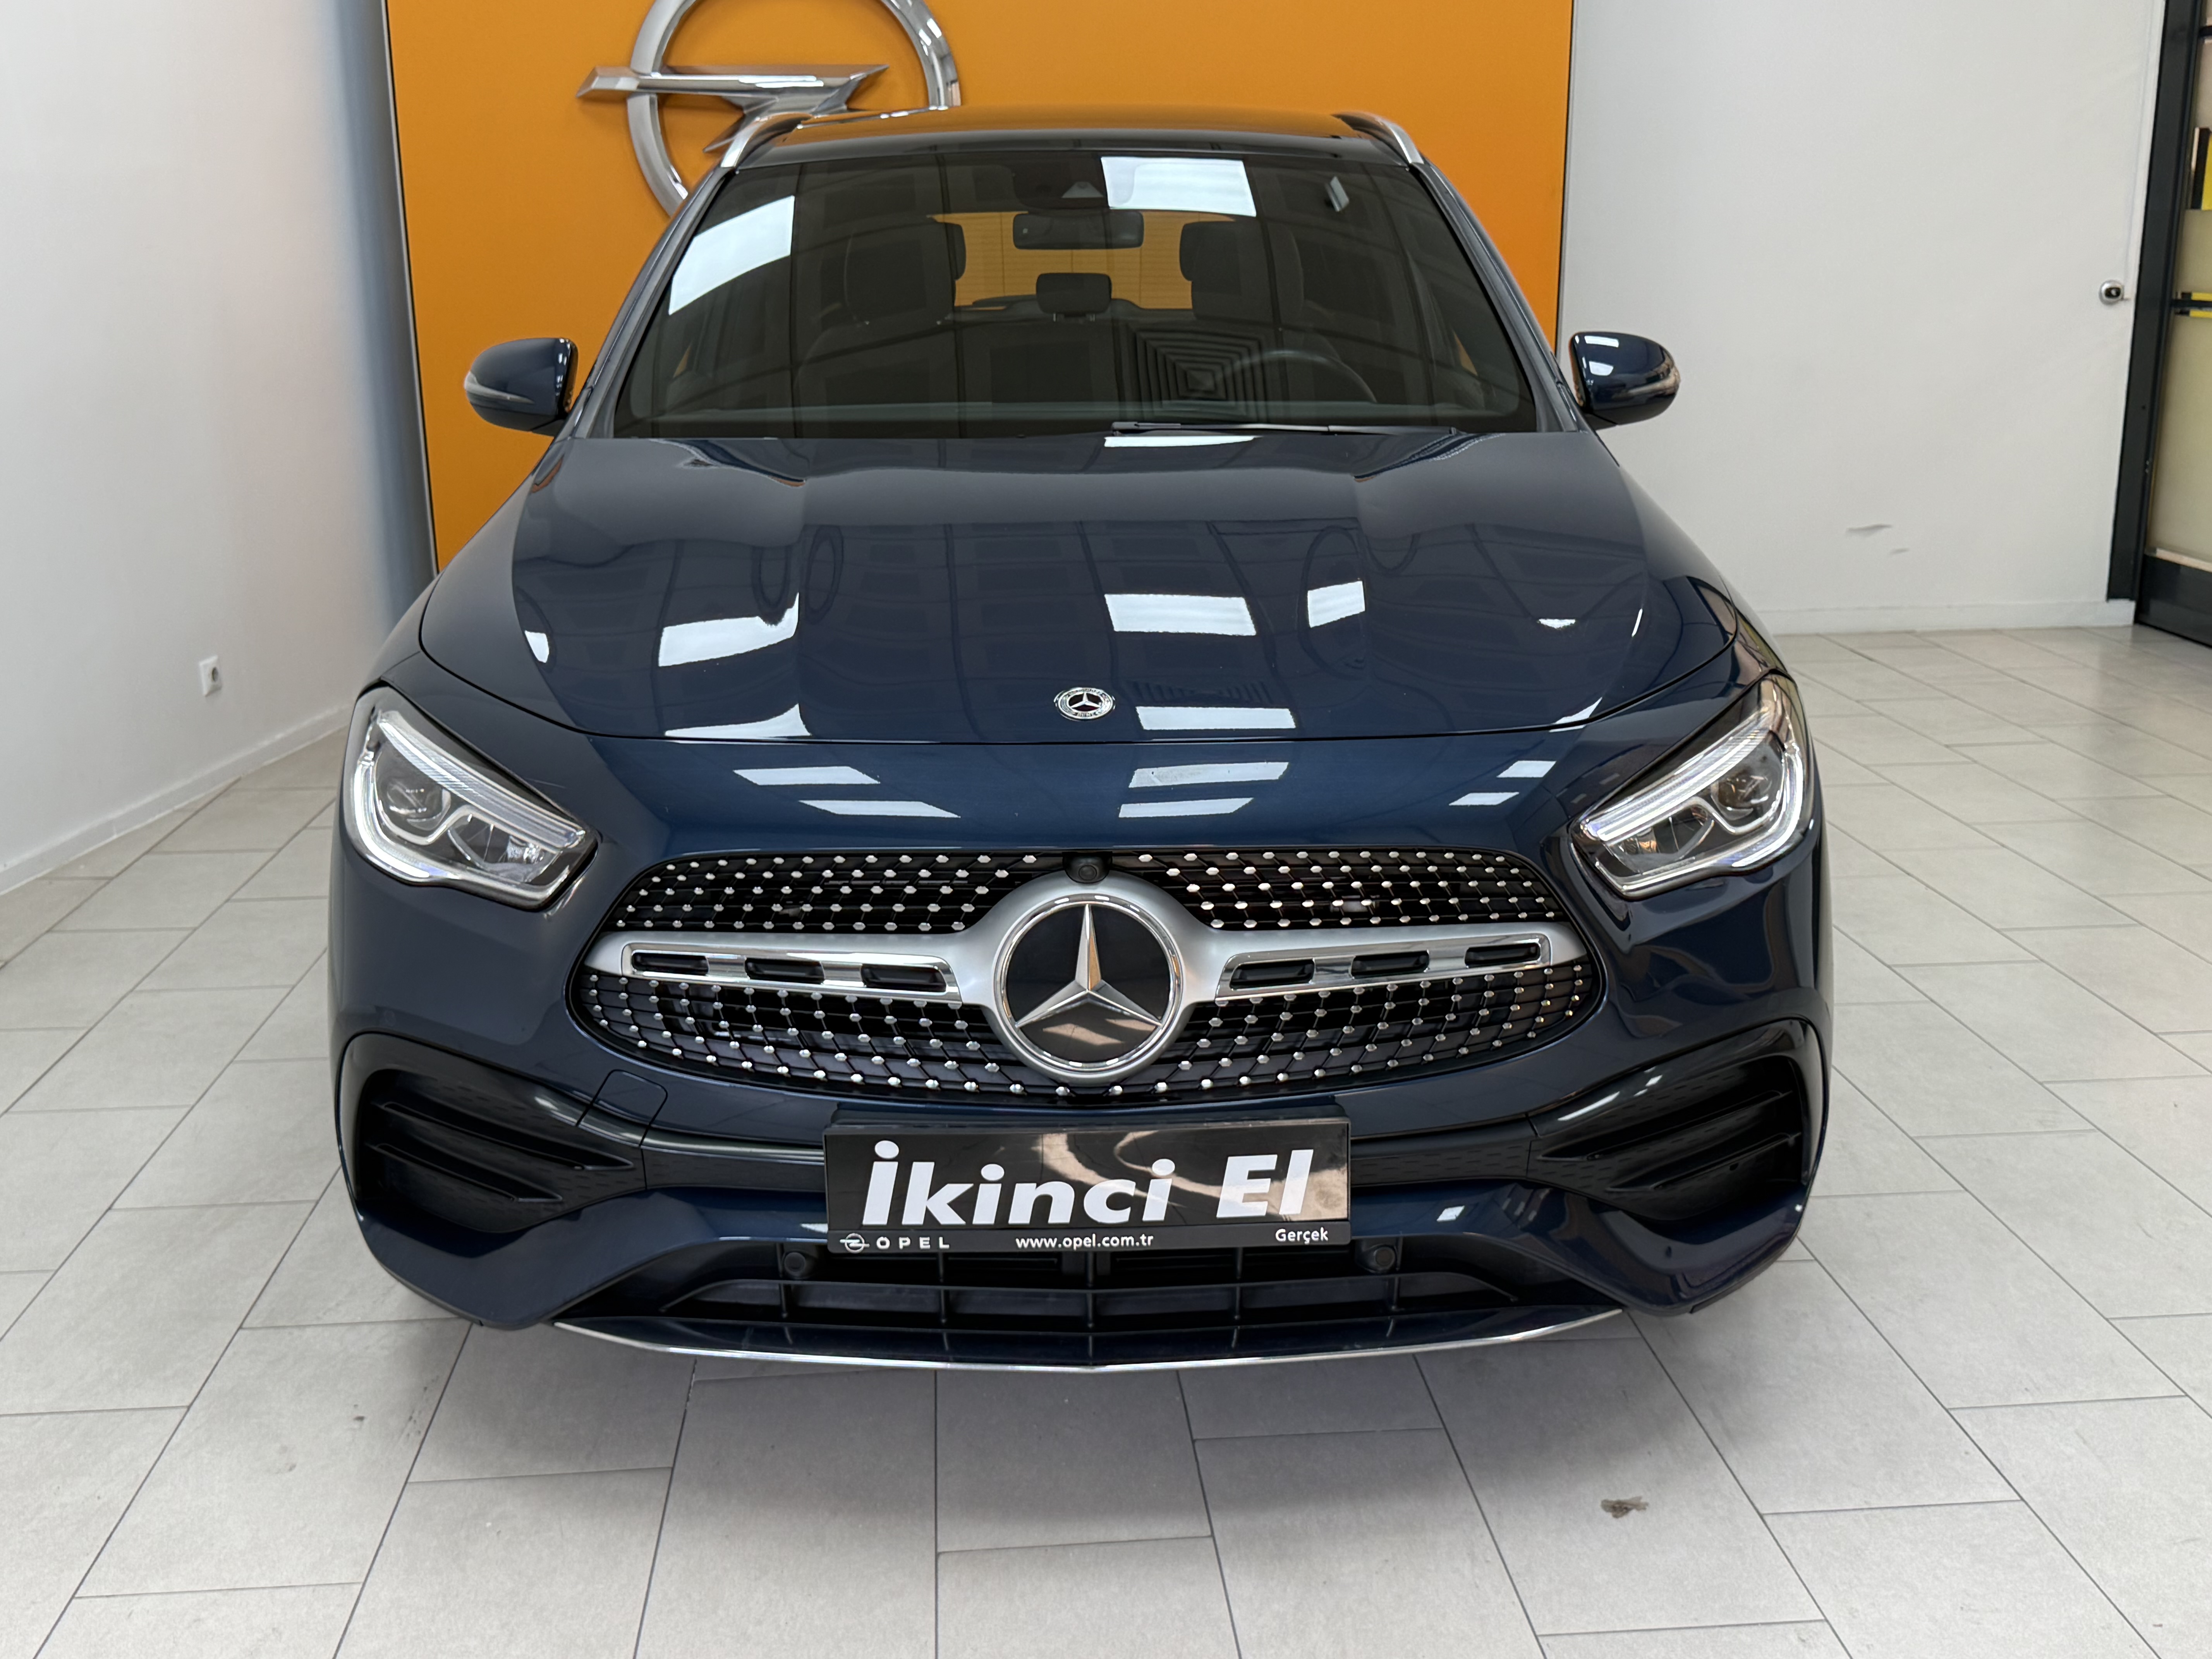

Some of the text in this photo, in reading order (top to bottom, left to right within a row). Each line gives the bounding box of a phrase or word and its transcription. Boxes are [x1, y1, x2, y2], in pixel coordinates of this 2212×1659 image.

[863, 1140, 1314, 1224] İkinci El
[876, 1236, 950, 1250] OPEL
[1015, 1233, 1154, 1251] www.opel.com.tr
[1275, 1227, 1329, 1245] Gerçek
